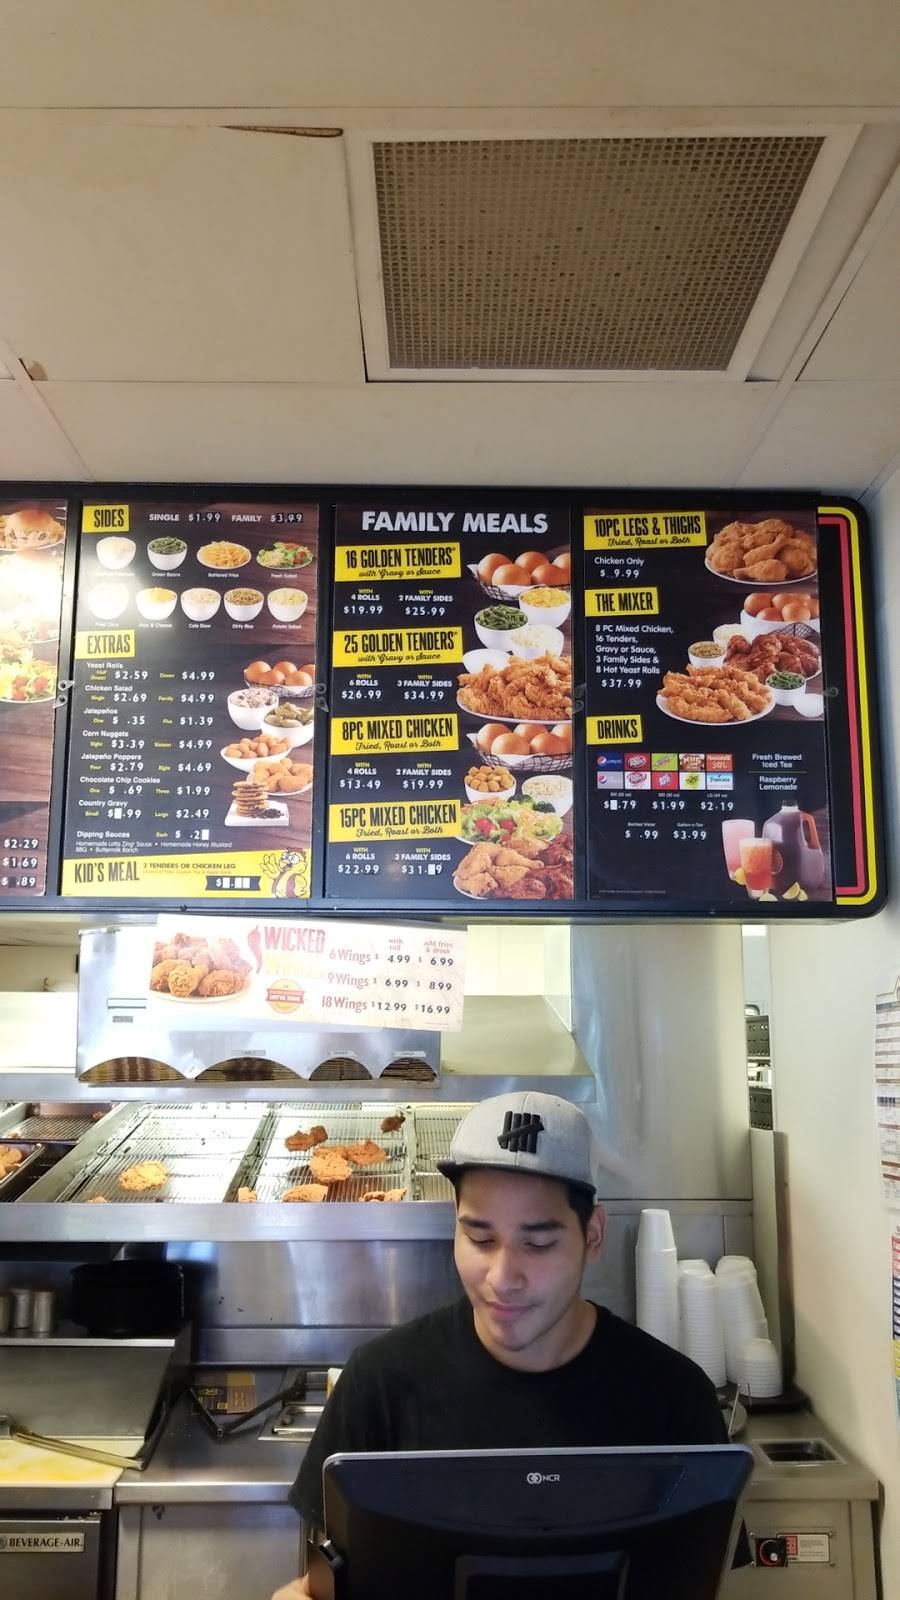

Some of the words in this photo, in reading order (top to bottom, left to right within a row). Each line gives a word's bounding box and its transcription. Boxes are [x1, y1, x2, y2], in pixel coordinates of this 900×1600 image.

[94, 509, 124, 528] SIDES
[188, 513, 221, 522] $1.99
[231, 514, 262, 522] FAMILY
[270, 513, 303, 523] $3.99
[362, 511, 455, 532] FAMILY
[463, 513, 548, 534] MEALS
[594, 519, 620, 537] 10PC
[623, 518, 649, 536] LEGS
[652, 517, 661, 535] &
[664, 516, 701, 534] THIGHS
[635, 537, 658, 546] Roast
[670, 536, 691, 544] Both
[346, 549, 357, 569] 16
[361, 548, 401, 568] GOLDEN
[594, 557, 624, 565] Chicken
[625, 557, 644, 566] Only
[359, 569, 377, 577] with
[378, 568, 403, 579] Gravy
[416, 568, 441, 576] Sauce
[595, 593, 615, 612] THE
[618, 592, 653, 611] MIXER
[344, 606, 383, 615] $19.99
[405, 607, 445, 616] $25.99
[615, 625, 639, 633] Mixed
[87, 634, 131, 655] EXTRAS
[344, 634, 358, 653] 25
[362, 633, 403, 653] GOLDEN
[605, 635, 638, 644] Tenders,
[595, 645, 619, 655] Gravy
[358, 654, 376, 662] with
[377, 653, 403, 664] Gravy
[416, 653, 441, 661] Sauce
[603, 656, 628, 665] Family
[629, 656, 650, 664] Sides
[652, 656, 659, 664] &
[604, 666, 617, 674] Hot
[115, 671, 148, 680] $2.59
[182, 672, 215, 680] $4.99
[601, 679, 641, 688] $37.99
[113, 693, 147, 703] $2.69
[181, 694, 214, 703] $4.99
[341, 690, 382, 699] $26.99
[404, 691, 444, 700] $34.99
[180, 717, 213, 726] $1.39
[100, 730, 128, 738] Nuggets
[342, 721, 363, 740] 8PC
[367, 720, 402, 740] MIXED
[406, 718, 452, 738] CHICKEN
[597, 719, 638, 739] DRINKS
[111, 740, 145, 749] $3.39
[179, 740, 212, 749] $4.99
[384, 740, 407, 751] Roast
[419, 739, 441, 748] Both
[110, 763, 144, 772] $2.79
[178, 763, 211, 772] $4.69
[80, 776, 114, 784] Chocolate
[115, 777, 131, 785] Chip
[340, 780, 381, 789] $13.49
[403, 780, 443, 789] $19.99
[759, 776, 797, 784] Raspberry
[177, 786, 210, 796] $1.99
[79, 800, 105, 808] Country
[107, 800, 127, 808] Gravy
[652, 801, 685, 810] $1.99
[700, 801, 734, 811] $2.19
[175, 809, 209, 819] $2.49
[340, 808, 366, 828] 15PC
[370, 807, 405, 826] MIXED
[409, 805, 456, 825] CHICKEN
[77, 831, 103, 839] Dipping
[385, 827, 408, 837] Roast
[421, 826, 443, 834] Both
[673, 830, 706, 840] $3.99
[4, 839, 38, 849] $2.29
[352, 853, 375, 861] ROLLS
[2, 858, 37, 867] $1.69
[74, 862, 104, 883] KID'S
[108, 861, 139, 882] MEAL
[338, 865, 379, 874] $22.99
[264, 926, 325, 953] WICKED
[329, 948, 336, 959] 6
[338, 948, 371, 965] Wings
[328, 973, 334, 984] 9
[336, 973, 369, 990] Wings
[321, 996, 332, 1008] 18
[334, 996, 367, 1013] Wings
